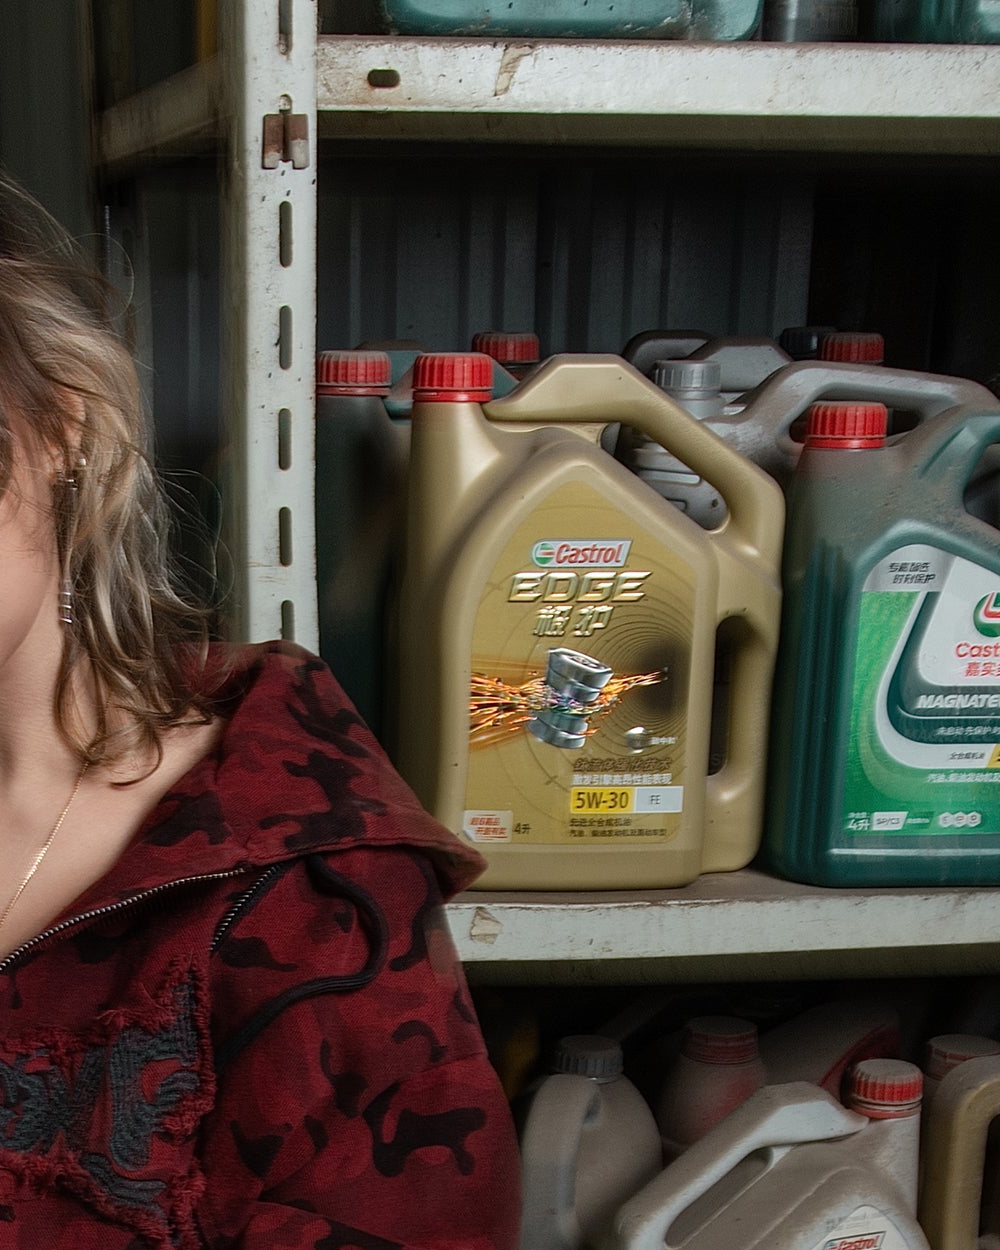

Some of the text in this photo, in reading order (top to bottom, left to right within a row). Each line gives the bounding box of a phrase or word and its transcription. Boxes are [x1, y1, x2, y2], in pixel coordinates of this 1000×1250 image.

[555, 543, 624, 564] Castrol
[508, 570, 652, 603] EDGE
[575, 790, 630, 810] 5W-30
